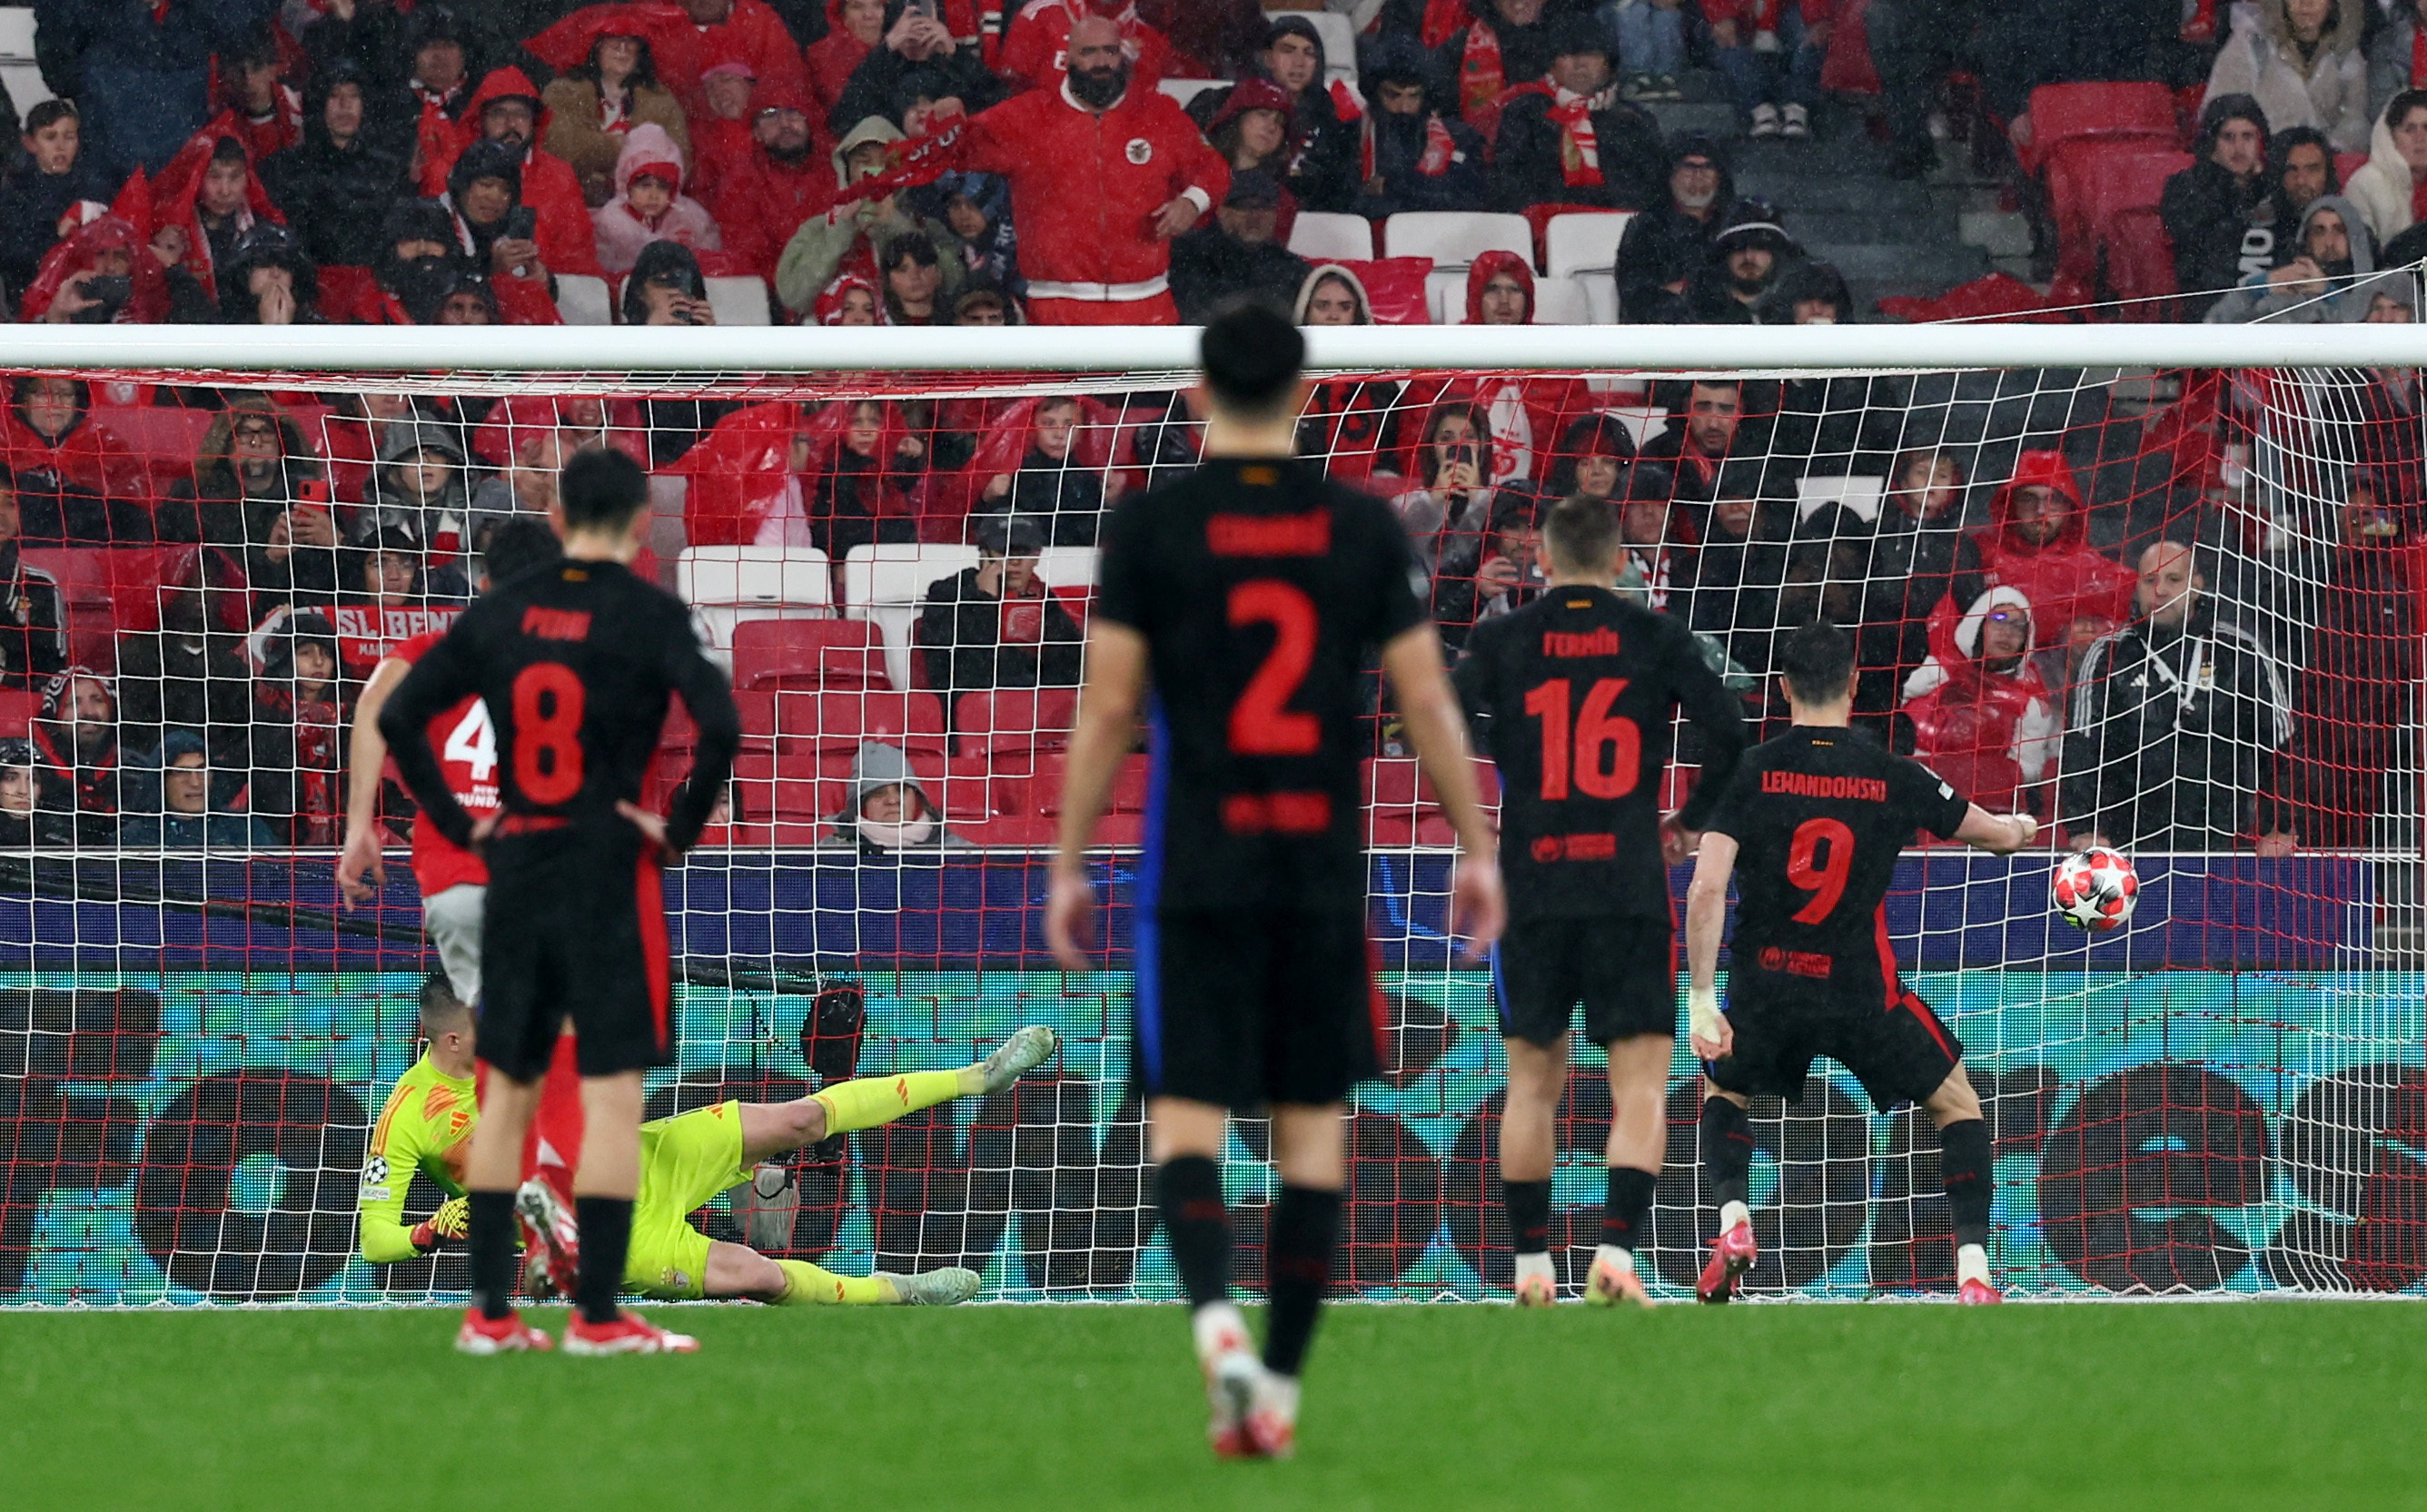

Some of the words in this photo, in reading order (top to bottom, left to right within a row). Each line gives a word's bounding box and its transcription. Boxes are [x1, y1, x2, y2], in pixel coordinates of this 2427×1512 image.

[337, 608, 378, 637] SL
[1225, 577, 1320, 756] 2
[443, 697, 499, 781] 4
[512, 663, 585, 805] 8
[1524, 677, 1641, 800] 16
[1761, 770, 1887, 803] LEWANDOWSKI
[1787, 818, 1856, 924] 9
